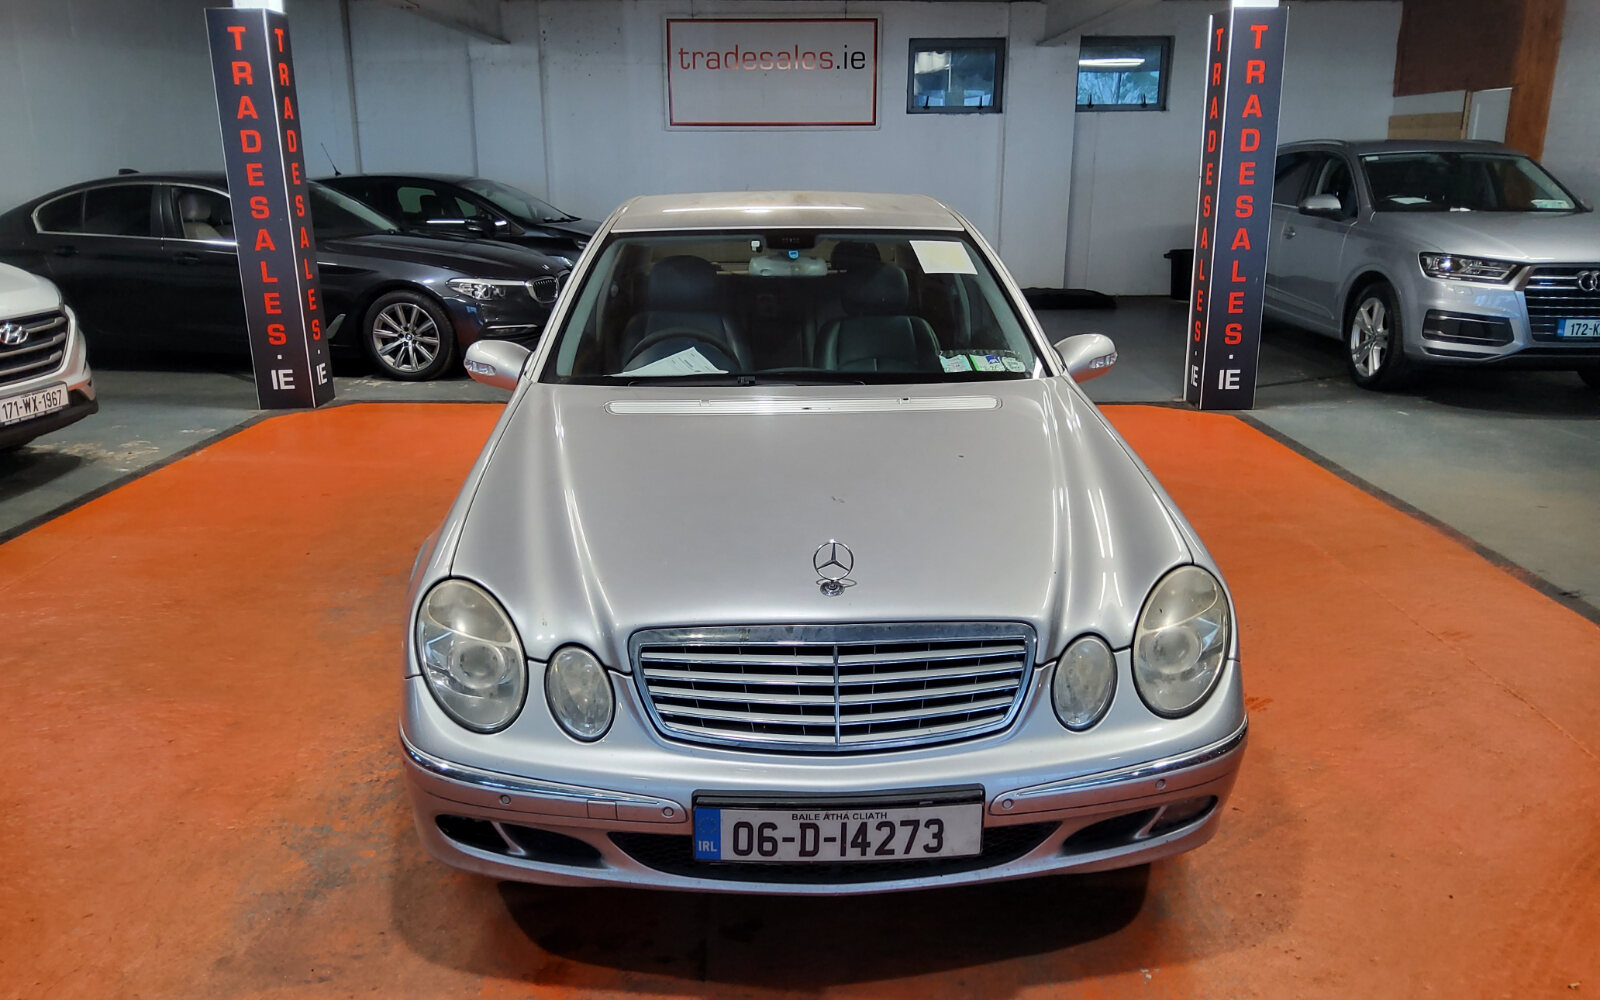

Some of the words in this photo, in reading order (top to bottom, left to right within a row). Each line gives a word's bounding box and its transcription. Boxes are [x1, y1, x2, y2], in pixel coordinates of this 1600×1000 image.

[678, 44, 865, 70] tradesales.ie
[1571, 322, 1600, 335] 172-K
[2, 389, 62, 419] 171-WX-1967
[791, 813, 820, 821] BAILE
[852, 811, 888, 821] CLIATH
[698, 841, 718, 853] IRL
[732, 818, 944, 857] 06-D-14273
